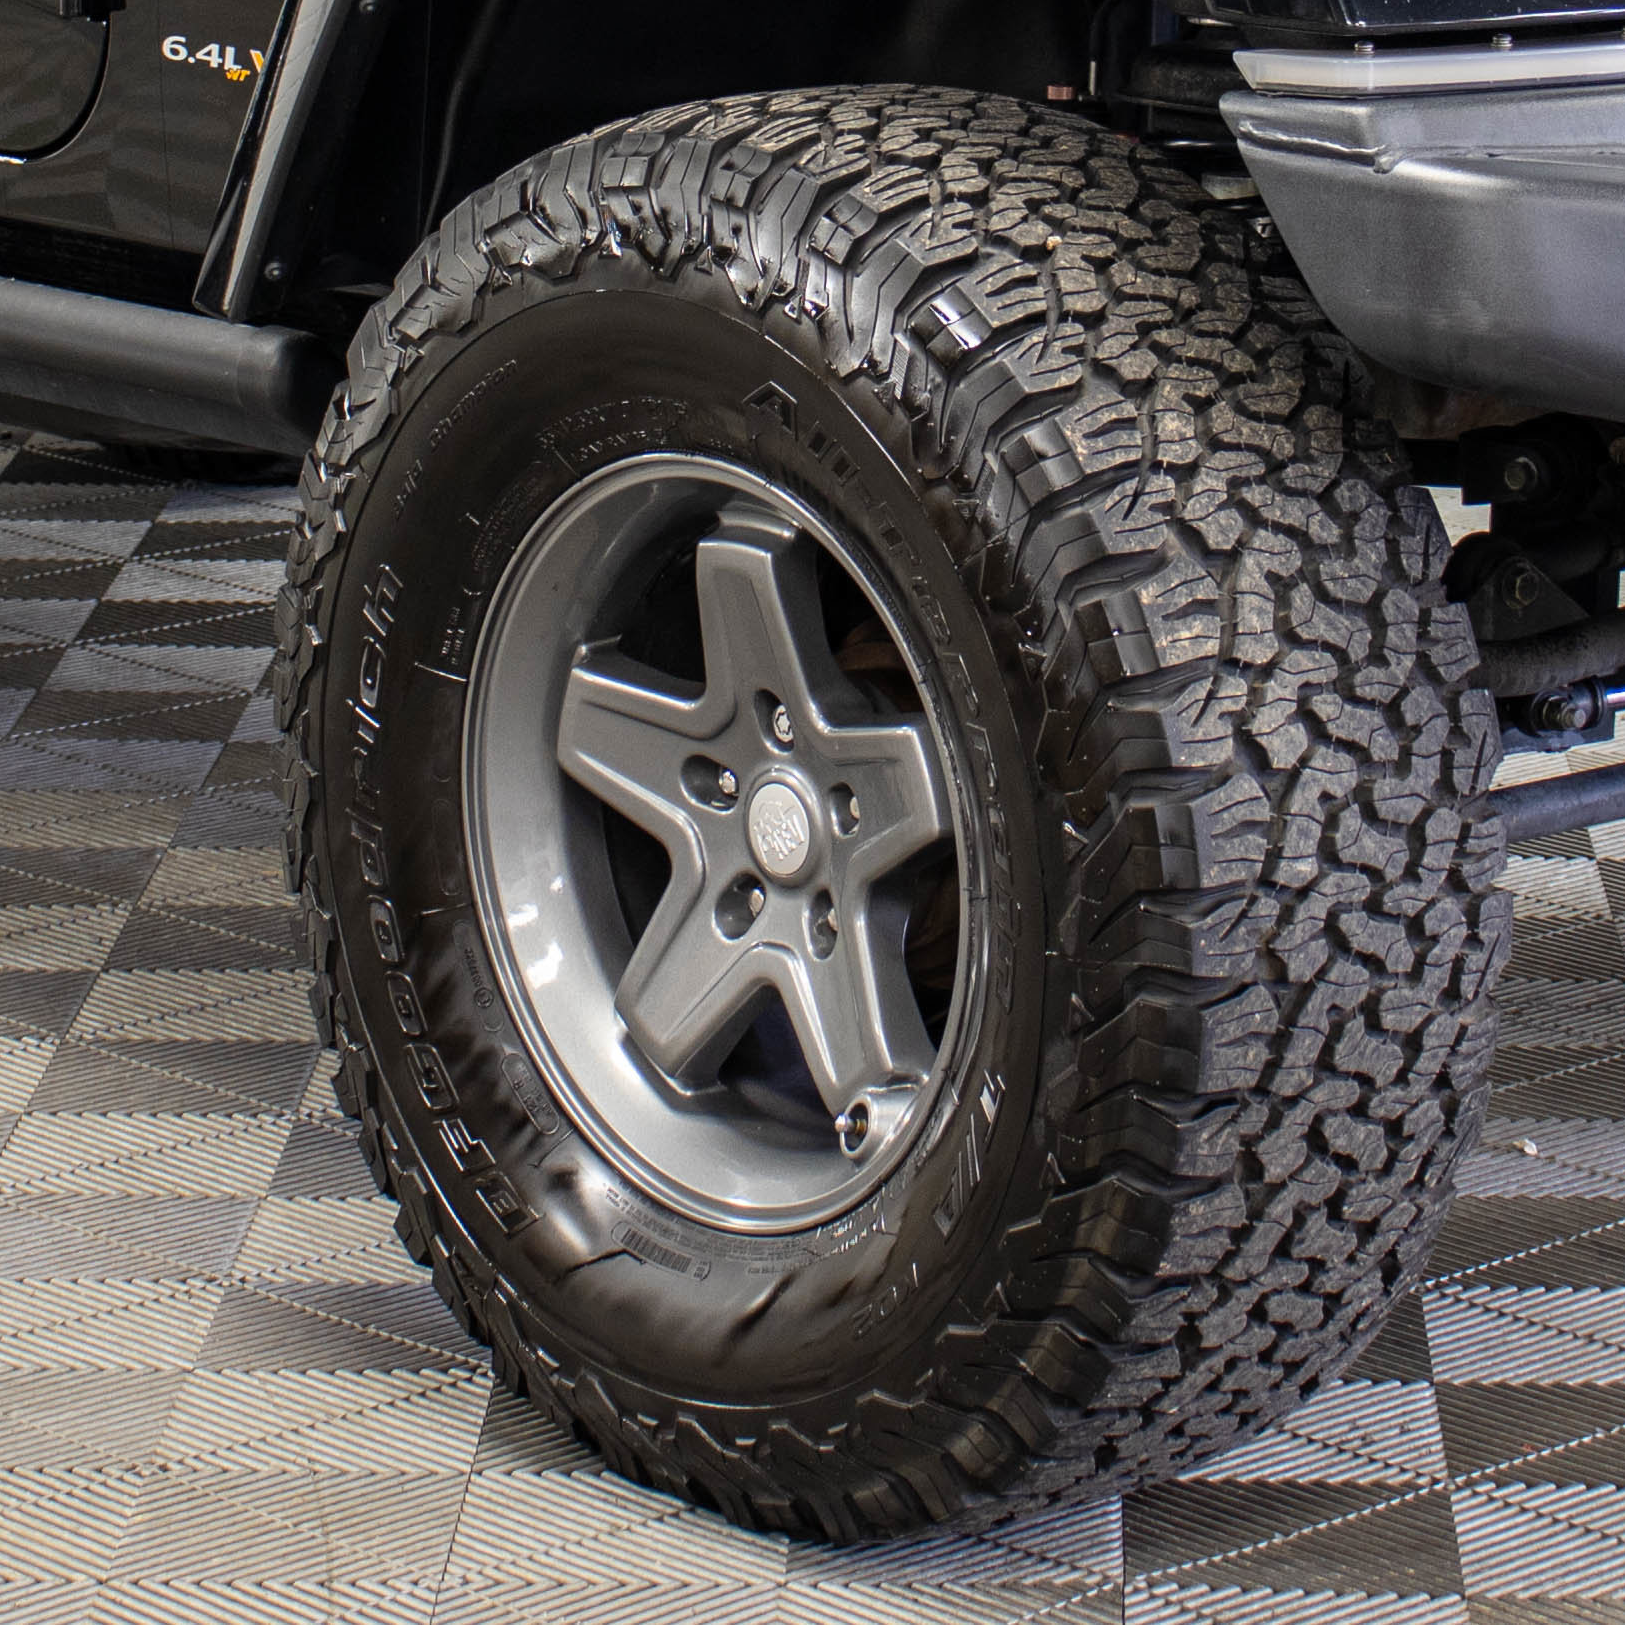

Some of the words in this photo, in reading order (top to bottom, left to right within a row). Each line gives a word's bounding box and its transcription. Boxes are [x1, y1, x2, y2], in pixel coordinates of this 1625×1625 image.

[161, 35, 242, 70] 6.4L
[346, 562, 545, 1239] BFGoodrich
[933, 1069, 1007, 1243] T/A
